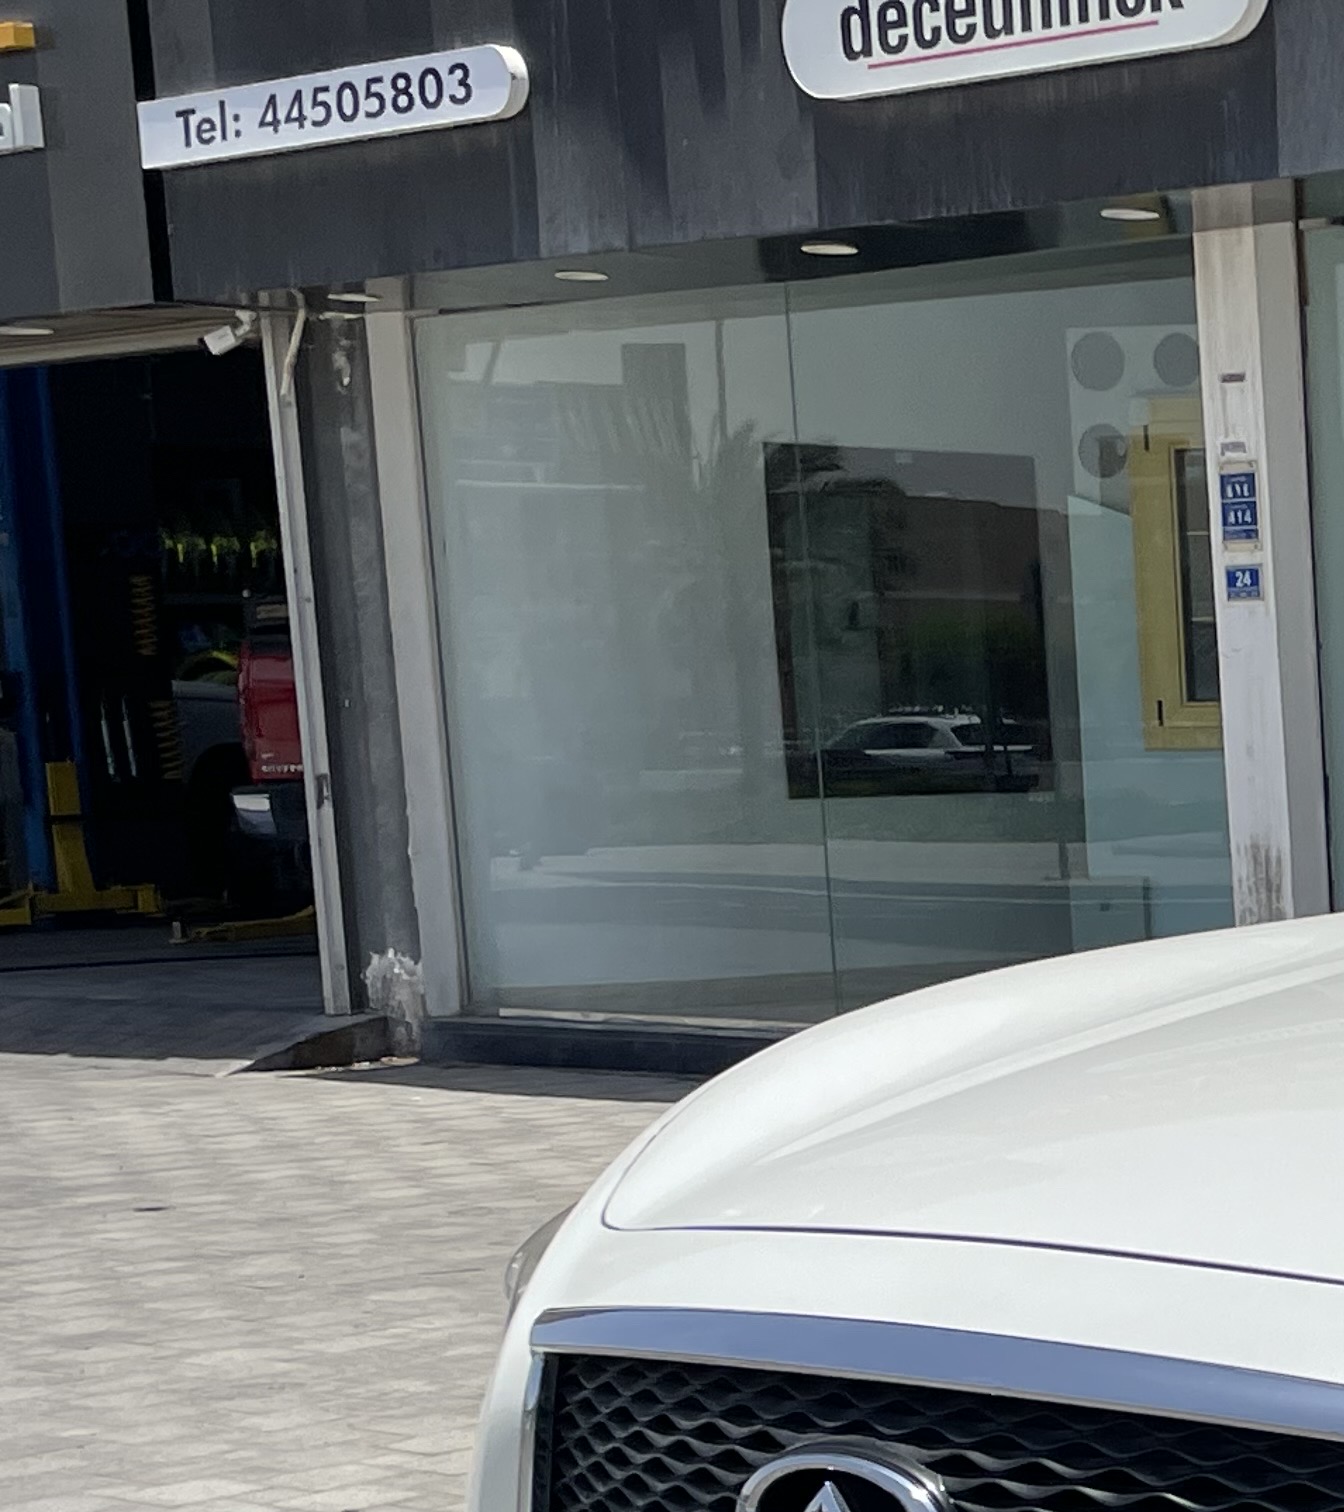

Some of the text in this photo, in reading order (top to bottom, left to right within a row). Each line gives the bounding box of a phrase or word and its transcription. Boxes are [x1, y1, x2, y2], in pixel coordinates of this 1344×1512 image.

[175, 62, 473, 149] Tel: 44505803
[1235, 570, 1252, 588] 24
